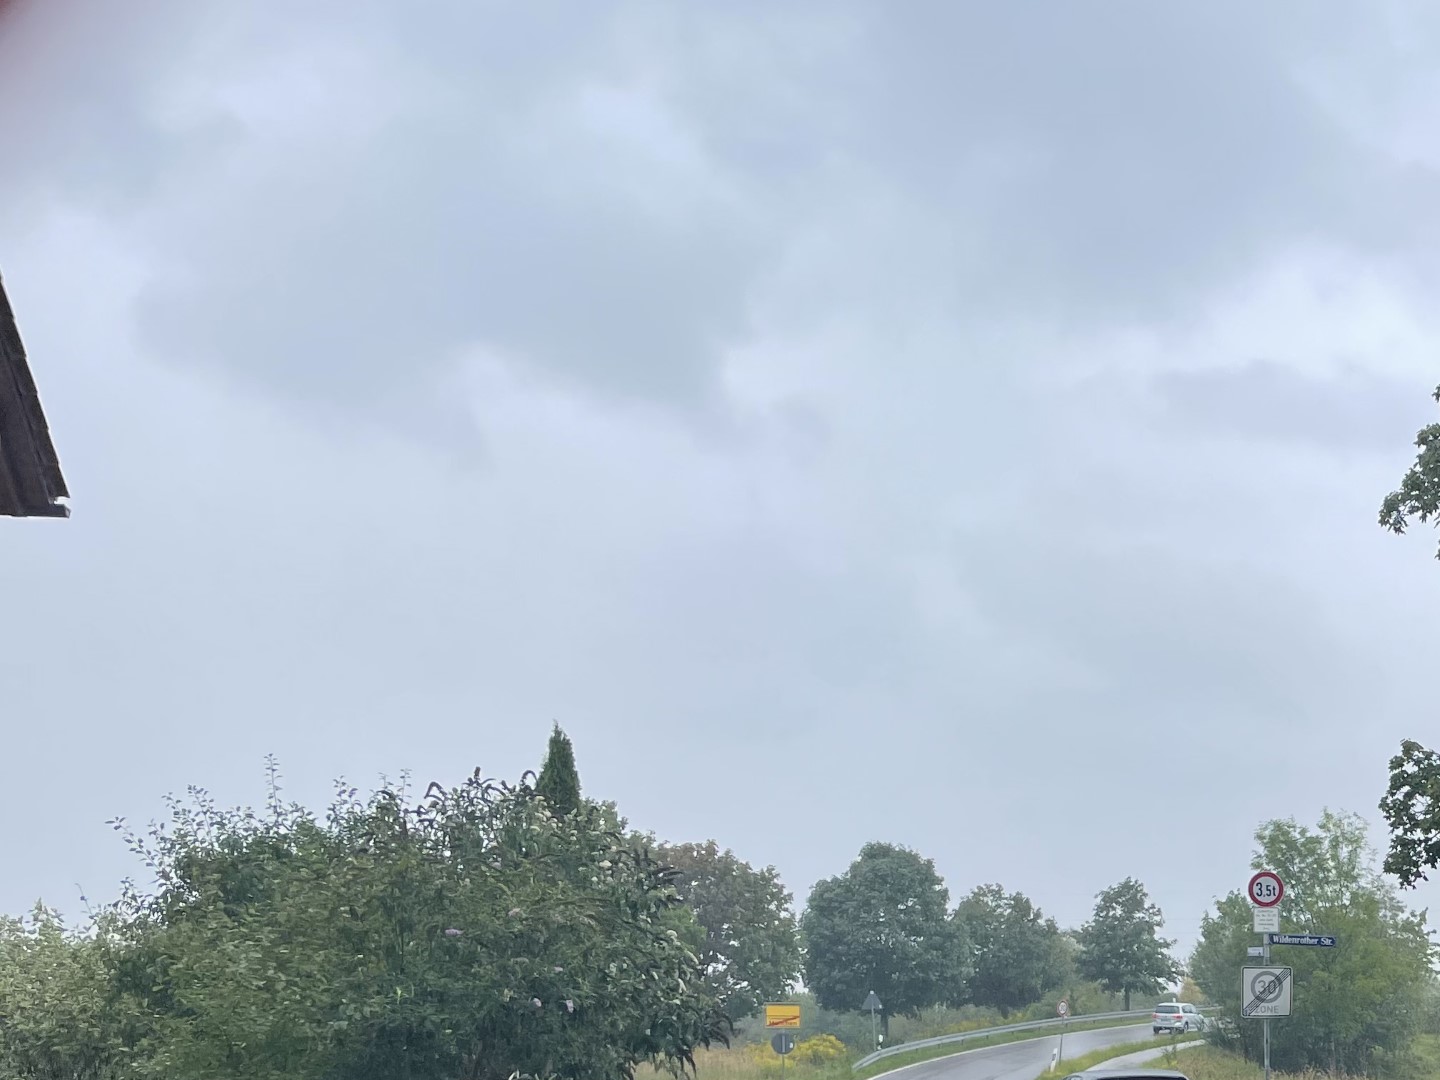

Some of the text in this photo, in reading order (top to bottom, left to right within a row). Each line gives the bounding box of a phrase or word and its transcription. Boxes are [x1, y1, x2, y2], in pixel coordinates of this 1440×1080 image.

[1273, 934, 1333, 946] Wildenrother Str.
[1255, 1005, 1279, 1014] ZONE
